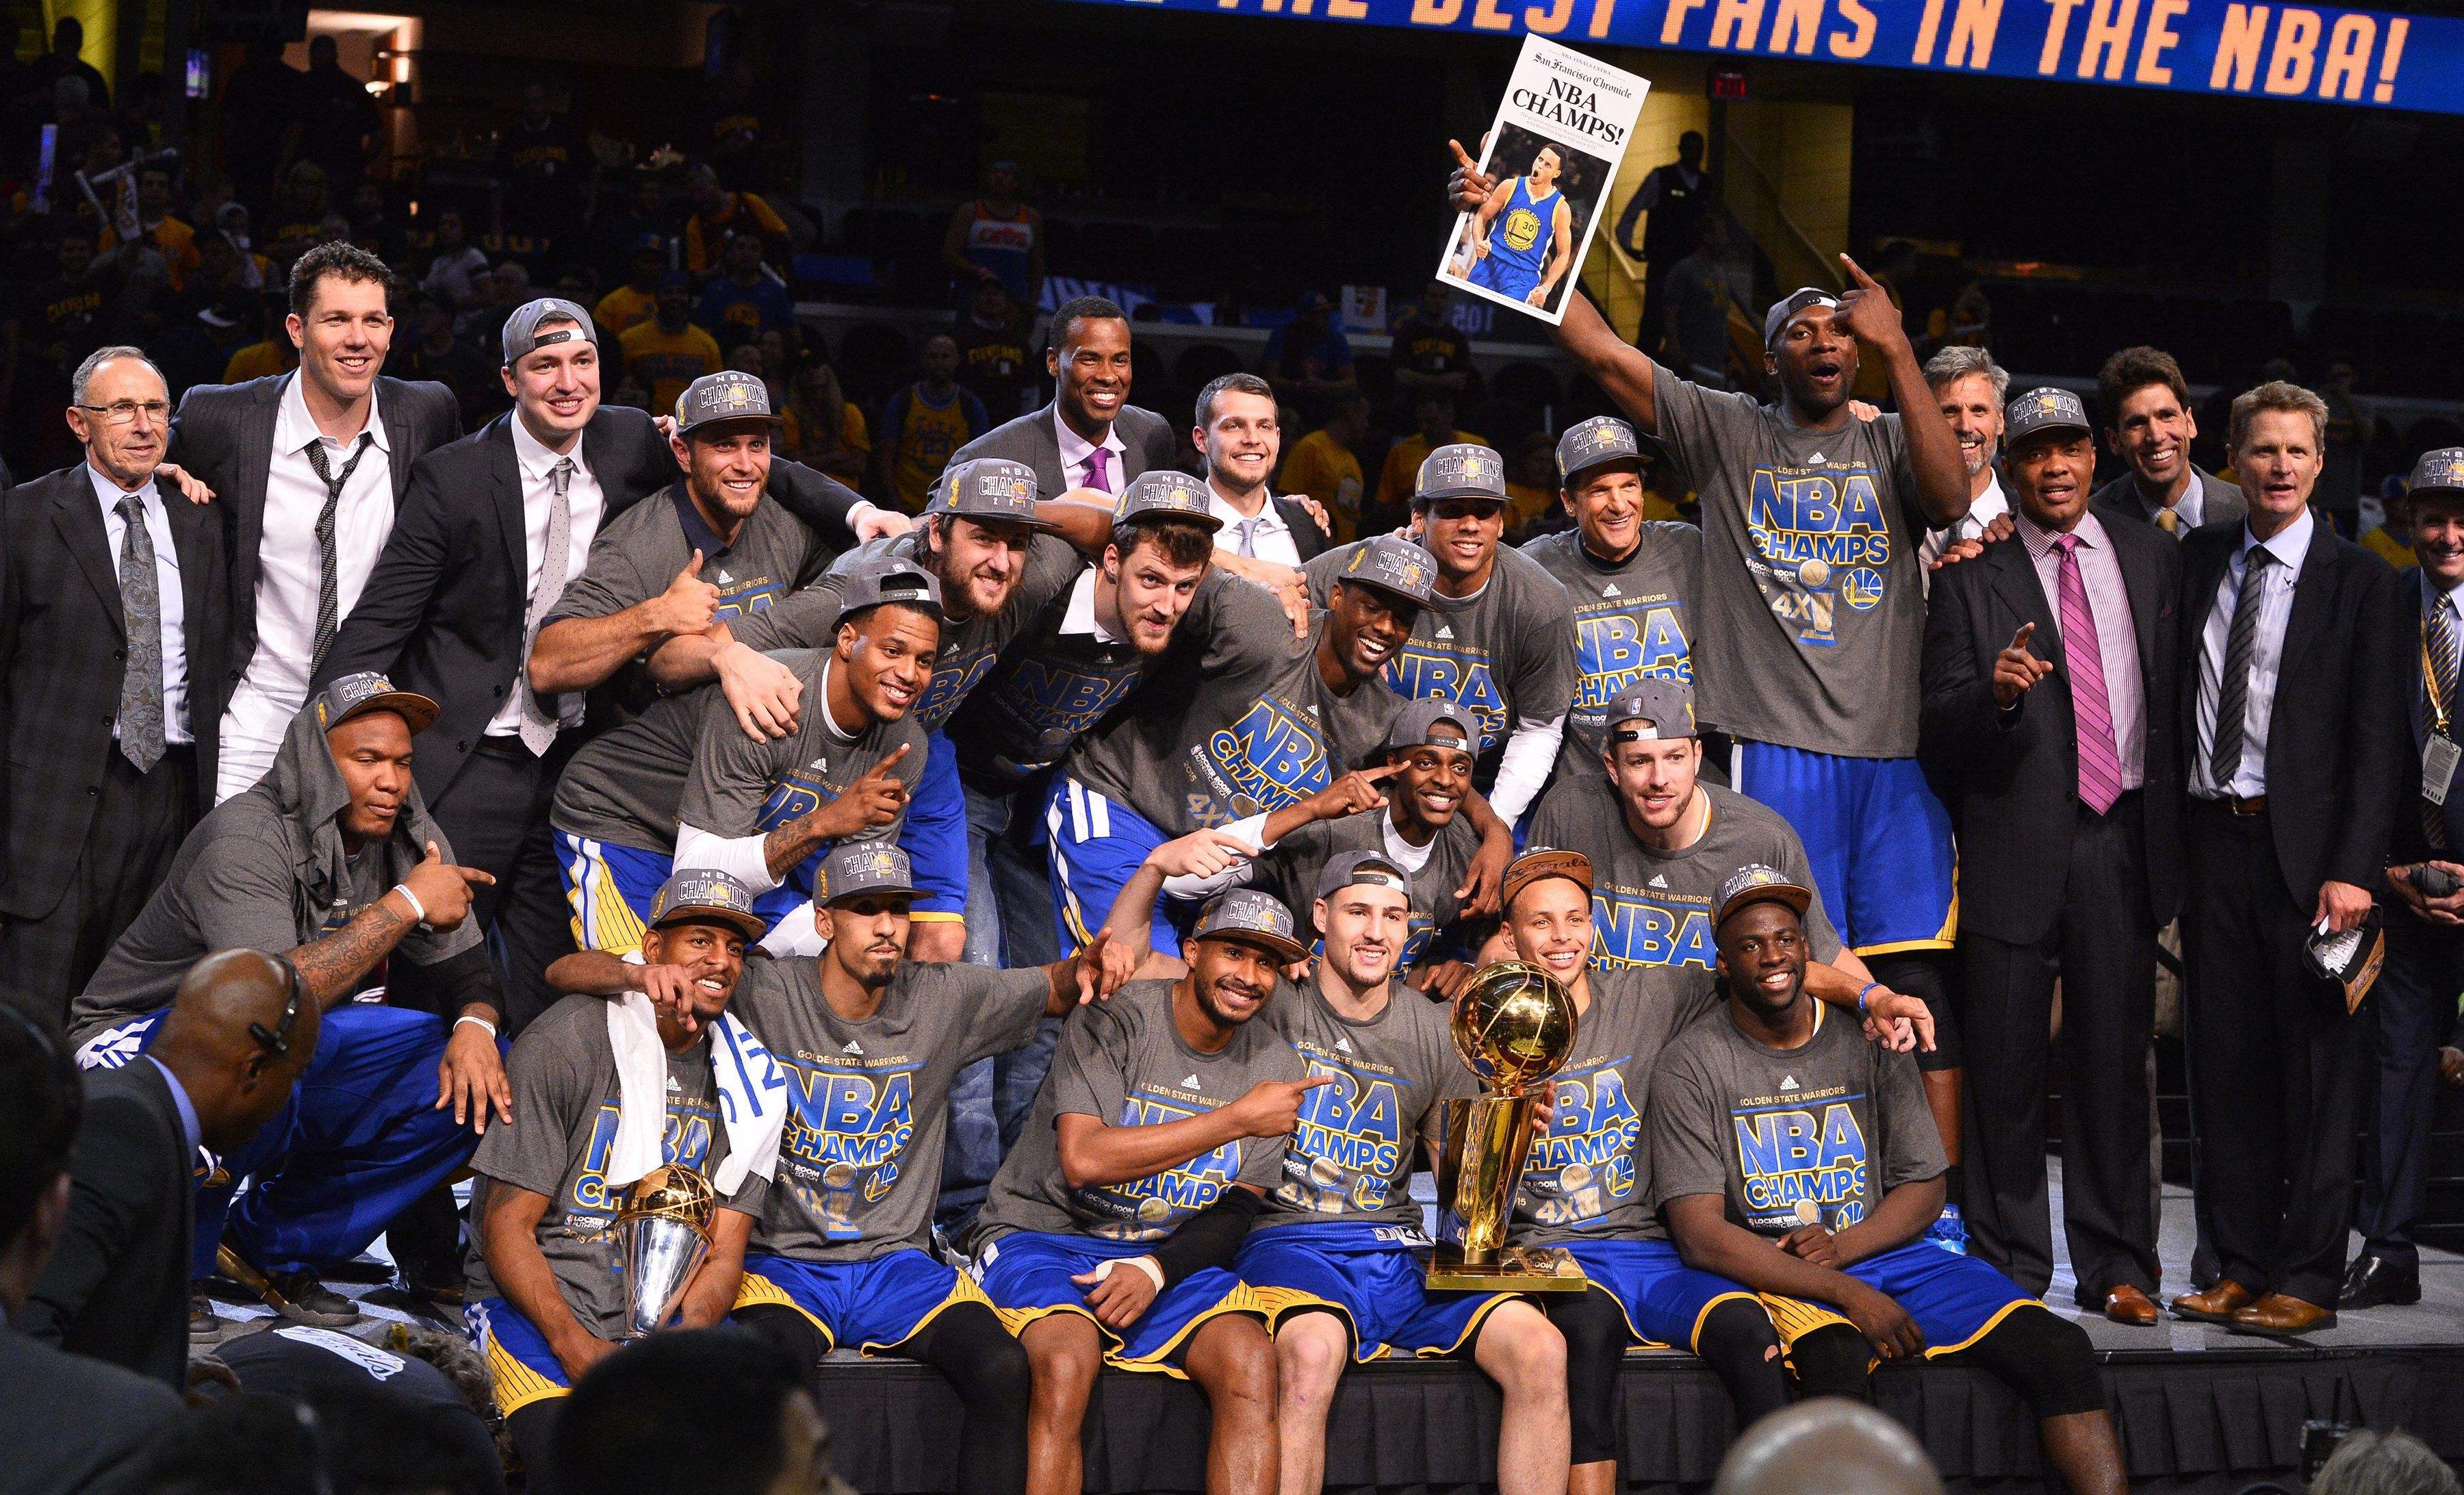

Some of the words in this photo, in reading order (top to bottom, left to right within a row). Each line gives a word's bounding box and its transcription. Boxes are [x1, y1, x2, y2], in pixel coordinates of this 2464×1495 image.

[1660, 0, 1877, 59] FANS
[1912, 0, 2005, 70] IN
[2038, 0, 2191, 86] THE
[2209, 3, 2410, 103] NBA!
[1533, 53, 1552, 67] San
[1552, 59, 1592, 83] Francisco
[1593, 77, 1632, 99] Chronicle
[1573, 56, 1592, 68] FINALS
[1592, 64, 1612, 77] EXTRA
[1546, 77, 1597, 114] NBA
[1513, 88, 1624, 145] CHAMPS!
[1522, 222, 1535, 232] 30
[1504, 232, 1533, 251] WARRIORS
[716, 374, 749, 383] NBA
[2027, 388, 2060, 397] NBA
[1584, 418, 1617, 428] NBA
[1001, 467, 1030, 477] NBA
[1774, 465, 1799, 475] LDEN
[1162, 475, 1194, 487] NBA
[1748, 469, 1888, 534] NBA
[1747, 526, 1890, 565] CHAMPS
[1400, 548, 1428, 565] NBA
[1774, 567, 1796, 578] ROOM
[719, 587, 735, 597] ATE
[1574, 603, 1595, 614] LDEN
[1597, 600, 1622, 610] STATE
[1623, 593, 1667, 606] WARRIORS
[1772, 591, 1812, 620] 4X
[1407, 638, 1426, 648] DEN
[1426, 641, 1452, 650] STATE
[912, 653, 996, 715] BA
[1387, 653, 1506, 712] NBA
[1295, 709, 1318, 728] STATE
[1230, 700, 1332, 795] NBA
[1183, 761, 1197, 782] 2015
[1194, 754, 1213, 784] AUTHENTIC
[1211, 780, 1229, 799] EDITION
[1196, 750, 1216, 780] LOCKER
[1214, 775, 1233, 795] ROOM
[1210, 730, 1302, 813] CHAM
[860, 842, 894, 851] NBA
[702, 871, 736, 884] NBA
[1251, 895, 1283, 910] NBA
[1640, 889, 1665, 900] STATE
[1591, 895, 1717, 971] NBA
[834, 1057, 862, 1066] STATE
[864, 1056, 908, 1068] WARRIORS
[1298, 1041, 1329, 1057] GOLEN
[1331, 1053, 1351, 1065] TATE
[1352, 1059, 1394, 1075] WARRIORS
[1574, 1055, 1610, 1071] WARRIO
[778, 1061, 914, 1136] NBA
[1172, 1090, 1197, 1103] STATE
[1547, 1068, 1639, 1138] BA
[1773, 1094, 1799, 1103] STATE
[1801, 1086, 1845, 1101] WARRIORS
[1285, 1121, 1400, 1176] HAMPS
[1524, 1118, 1641, 1171] HAMPS
[1734, 1103, 1866, 1178] NBA
[794, 1164, 820, 1177] ROOM
[1283, 1158, 1308, 1171] ROOM
[1286, 1166, 1306, 1177] DITION
[1744, 1164, 1866, 1210] CHAMPS
[1113, 1205, 1135, 1215] ROOM
[1535, 1195, 1580, 1224] 4X
[573, 1215, 604, 1226] LOCKER
[1754, 1217, 1782, 1225] LOCKER
